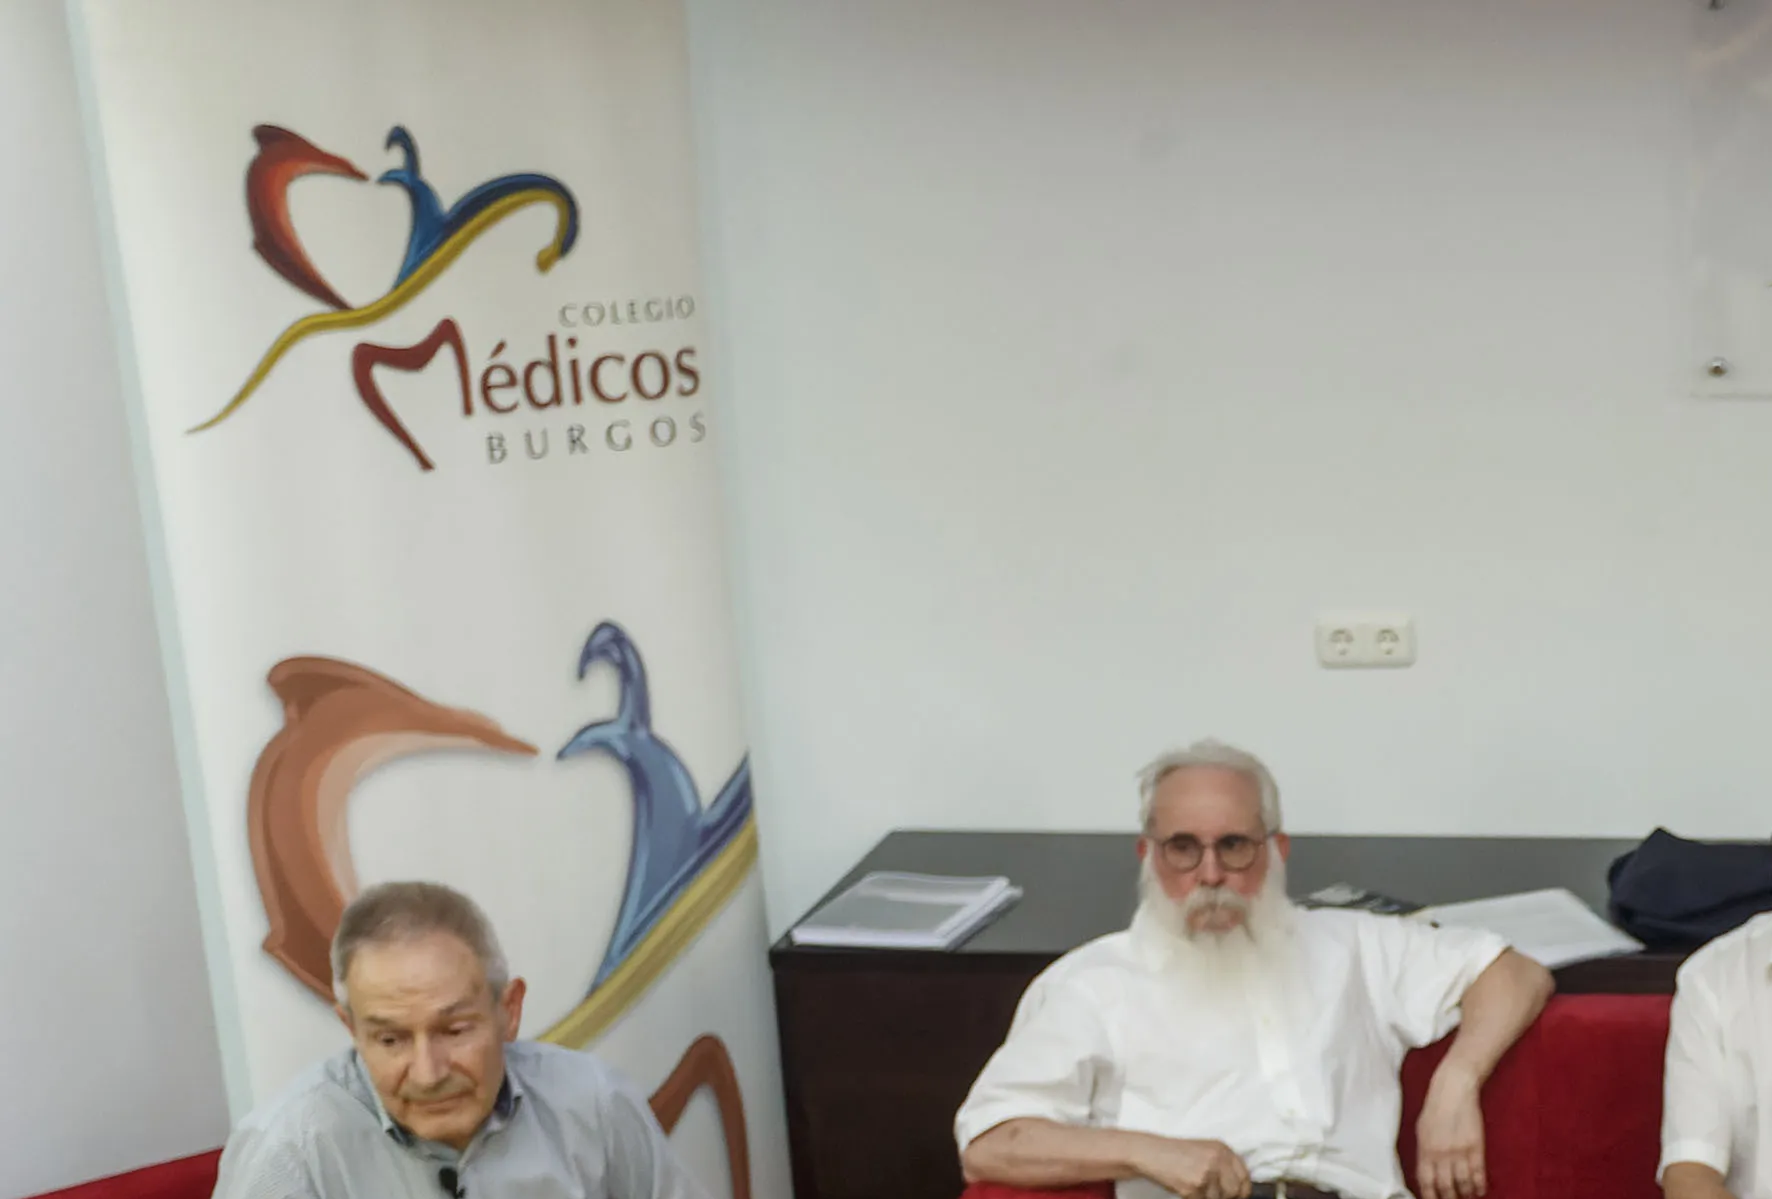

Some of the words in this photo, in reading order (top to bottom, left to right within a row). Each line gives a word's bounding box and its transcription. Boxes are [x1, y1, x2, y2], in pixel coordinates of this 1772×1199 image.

[558, 295, 696, 328] COLEGIO
[352, 318, 701, 471] Médicos
[486, 410, 707, 465] BURGOS
